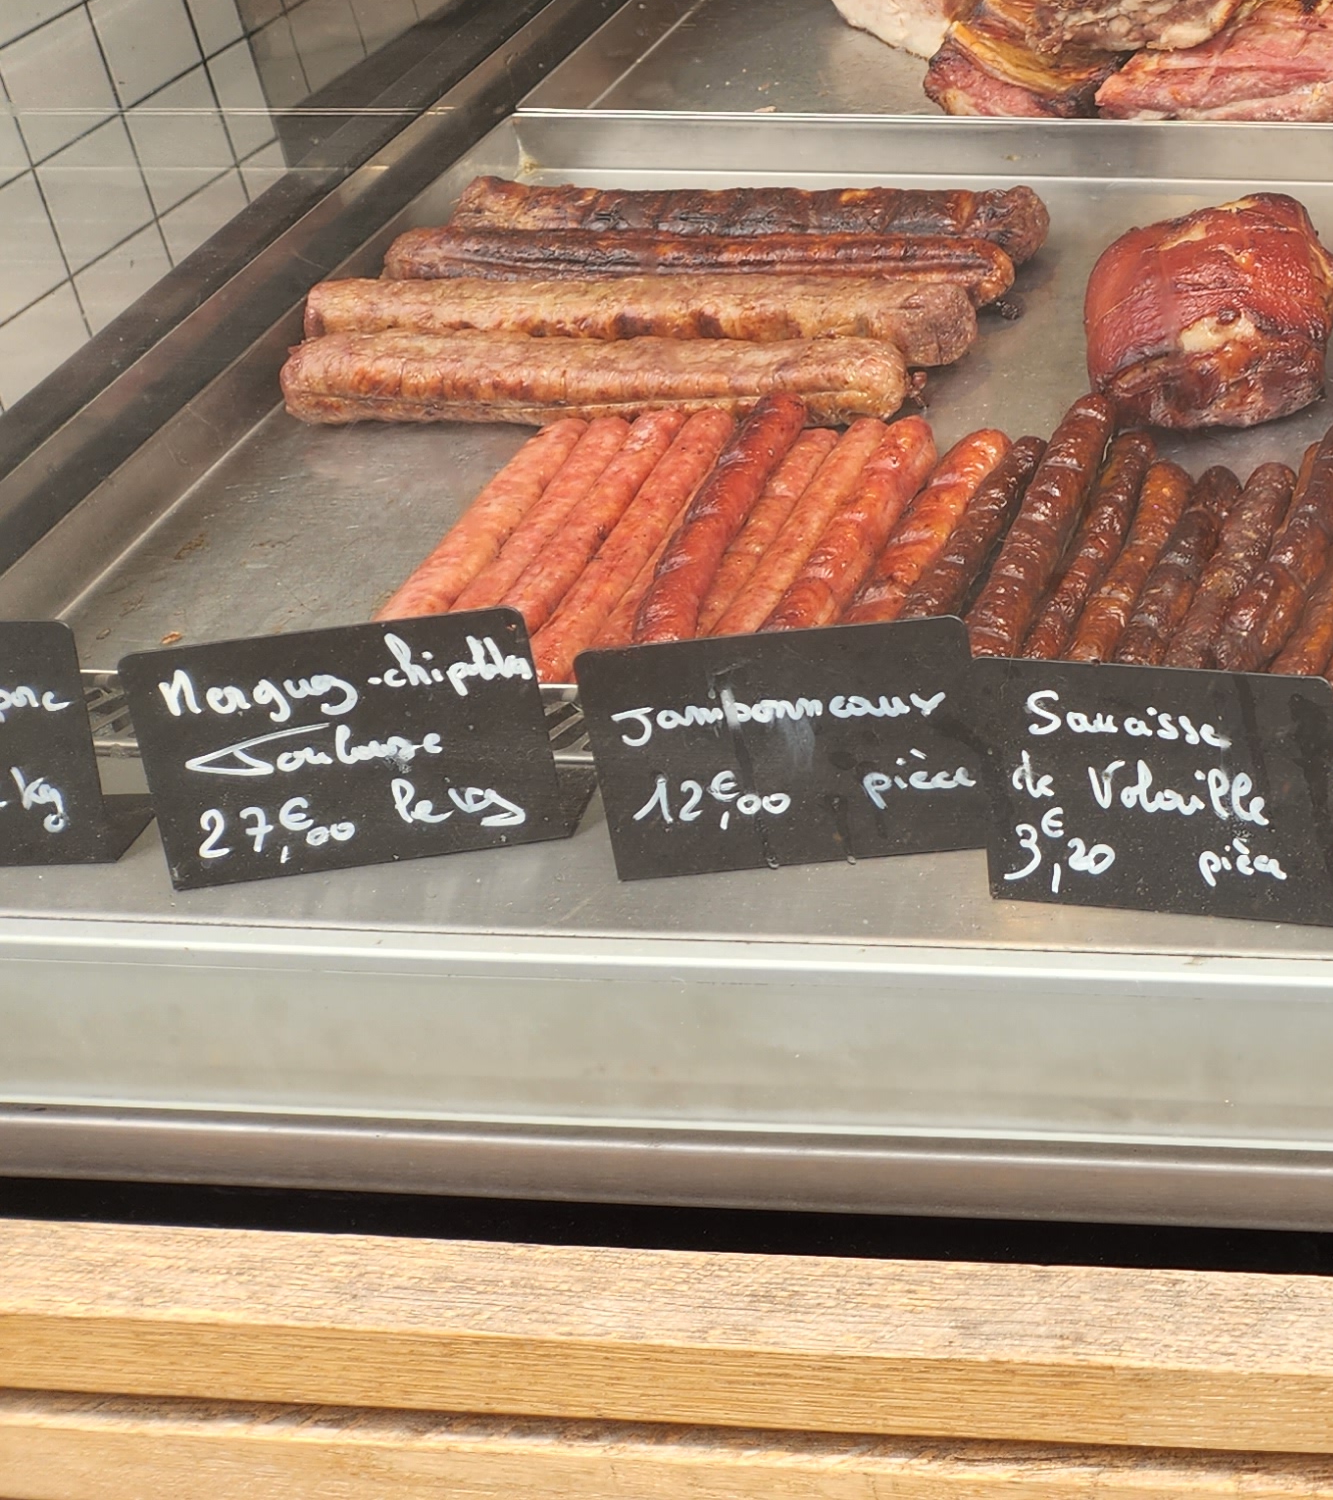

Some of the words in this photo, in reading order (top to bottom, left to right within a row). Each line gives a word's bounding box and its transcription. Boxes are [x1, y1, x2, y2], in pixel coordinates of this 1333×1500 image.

[611, 687, 946, 746] Jambonneaux
[185, 722, 443, 776] Toulouse
[391, 778, 454, 824] le
[862, 748, 976, 810] pièce
[1012, 750, 1055, 798] de
[1088, 759, 1270, 826] Volaille
